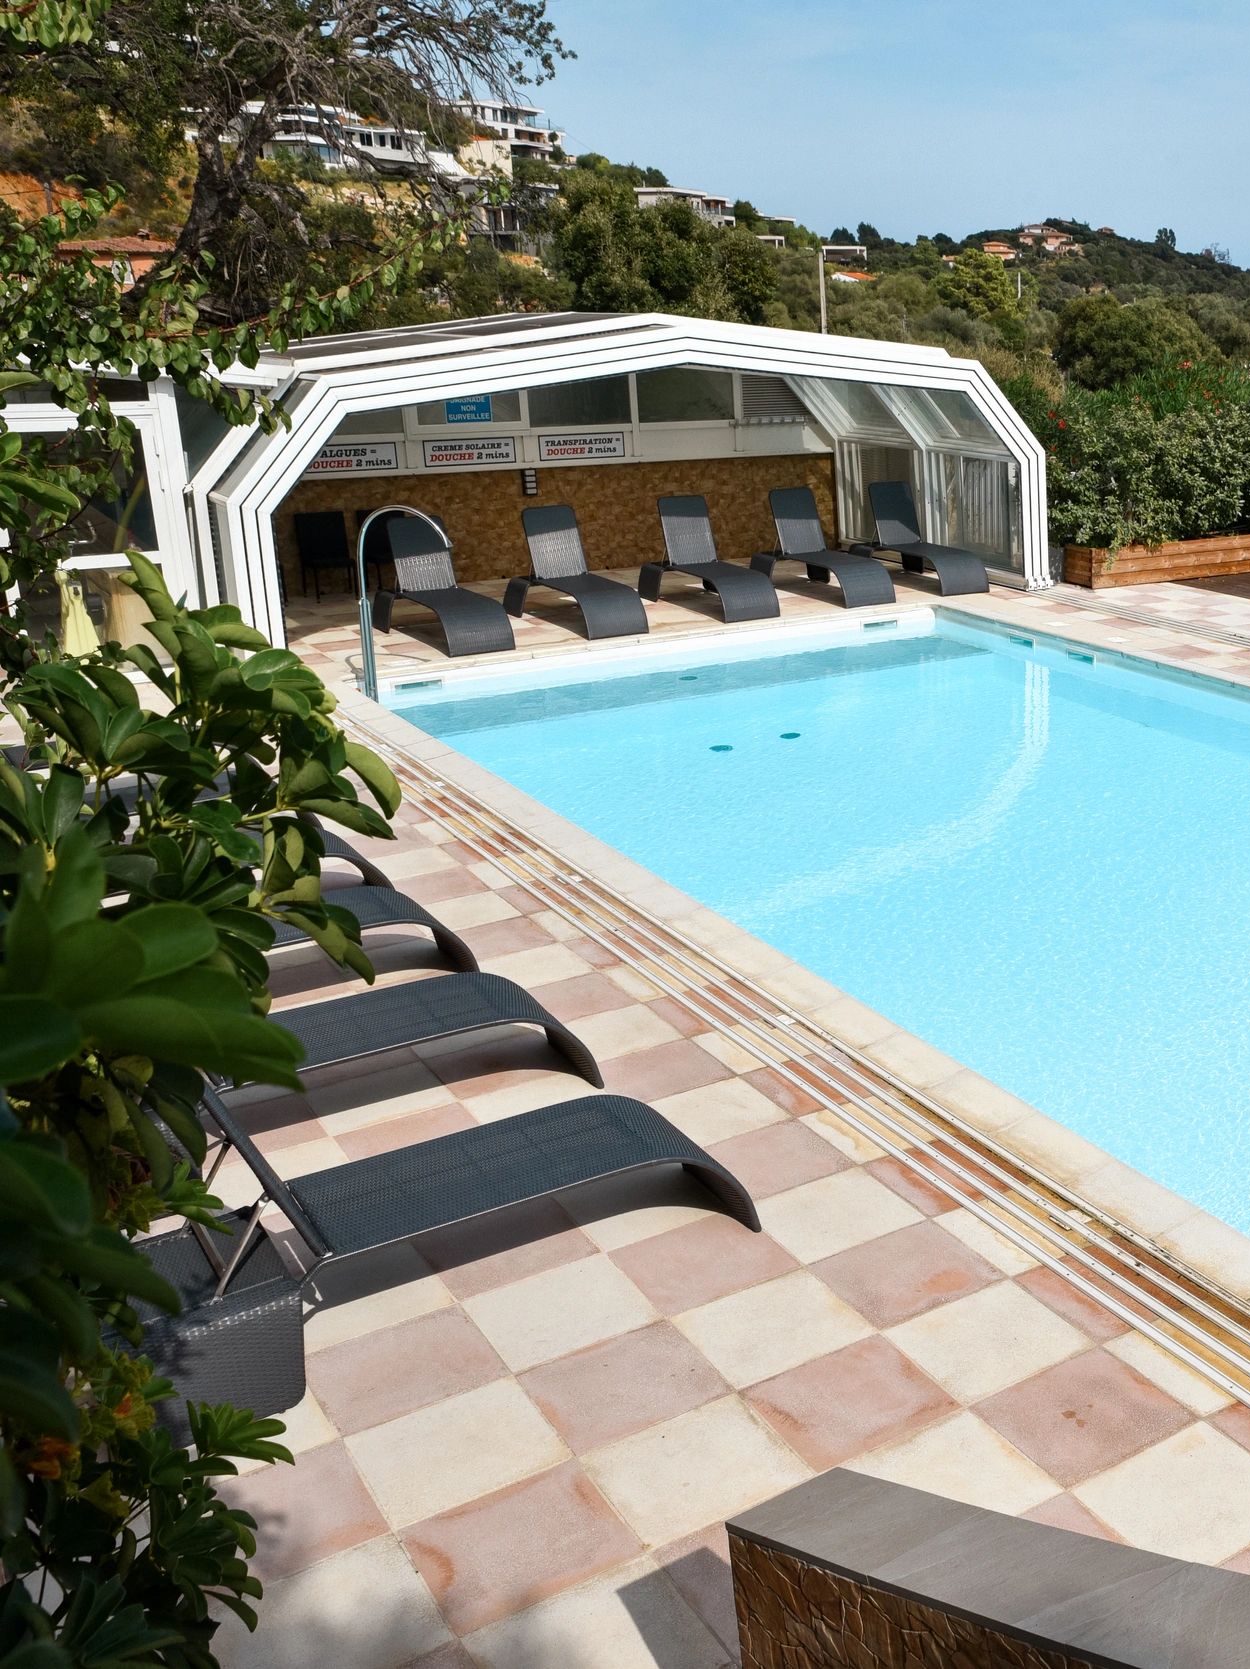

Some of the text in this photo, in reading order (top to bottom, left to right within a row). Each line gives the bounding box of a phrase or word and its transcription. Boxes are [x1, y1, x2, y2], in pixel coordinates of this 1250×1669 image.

[460, 404, 476, 412] NON
[448, 412, 490, 420] SURVEILLEE
[431, 444, 463, 452] CREME
[464, 442, 502, 450] SOLAIRE
[545, 437, 613, 447] TRANSPIRATION
[320, 448, 367, 458] ALGUES
[546, 445, 617, 456] DOUCHE 2 mins
[430, 450, 510, 462] DOUCHE 2 mins
[355, 458, 363, 467] 2
[365, 457, 393, 467] mins
